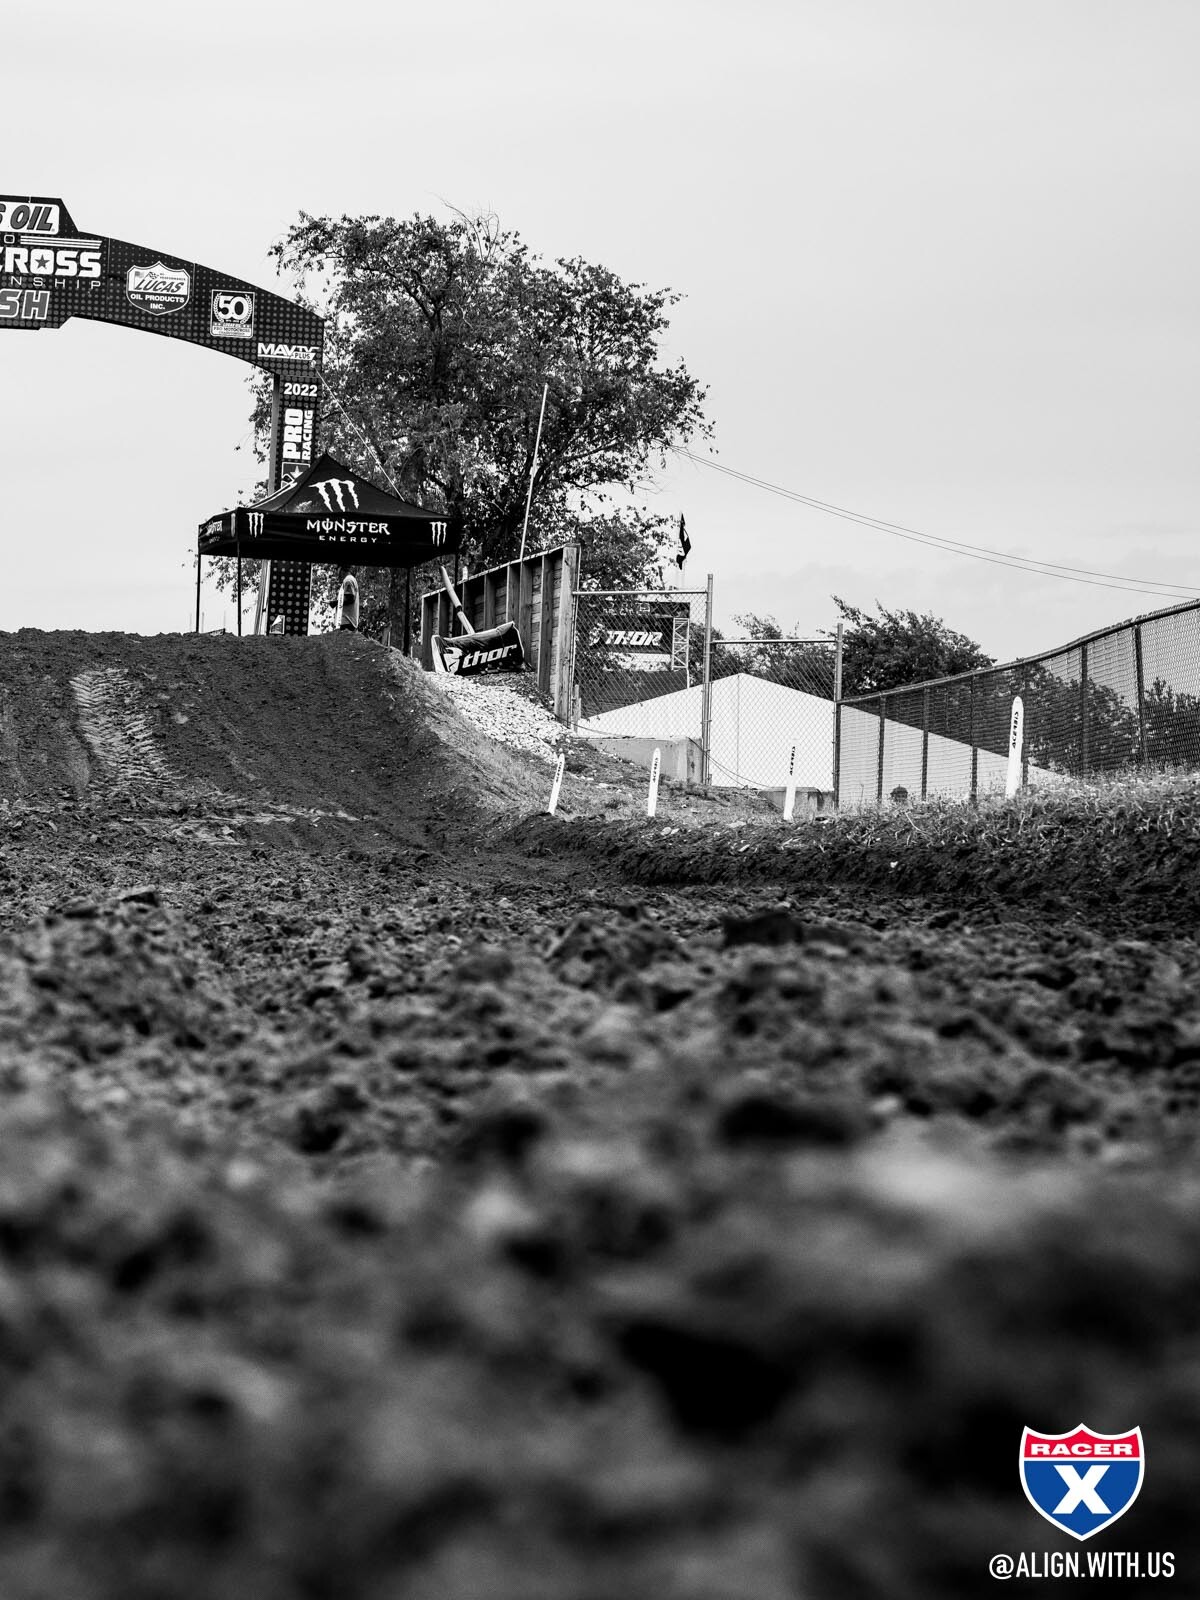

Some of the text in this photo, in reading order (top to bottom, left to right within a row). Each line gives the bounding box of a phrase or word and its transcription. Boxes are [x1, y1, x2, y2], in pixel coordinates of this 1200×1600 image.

[10, 204, 54, 231] OIL
[134, 279, 185, 293] LUCAS
[145, 294, 185, 303] PRODUCTS
[218, 295, 249, 320] 50
[294, 352, 311, 360] PLUS
[284, 382, 318, 397] 2022
[282, 408, 304, 460] PRO
[302, 410, 314, 461] RACING
[306, 518, 391, 536] MONSTER
[319, 535, 378, 544] ENERGY
[604, 630, 663, 646] THOR
[461, 644, 518, 669] thor
[1011, 711, 1019, 749] ACERBIS
